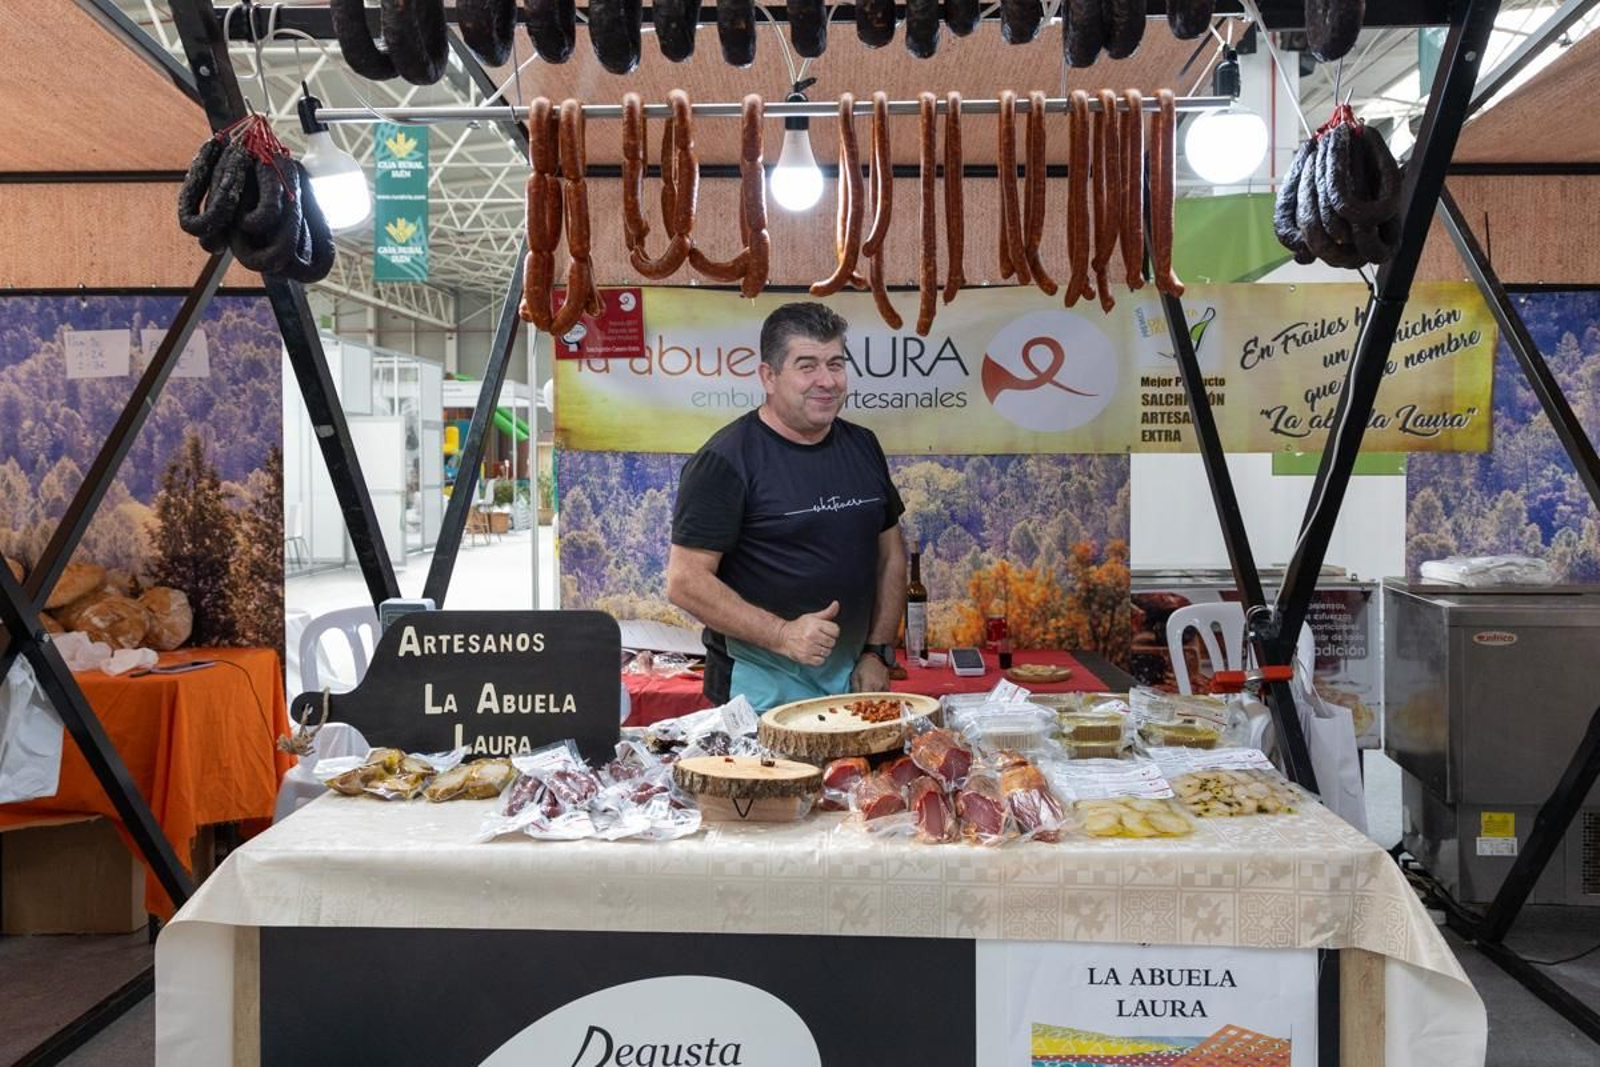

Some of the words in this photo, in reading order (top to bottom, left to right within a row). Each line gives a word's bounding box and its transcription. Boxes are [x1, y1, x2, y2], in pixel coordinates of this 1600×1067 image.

[1240, 336, 1276, 370] En
[1271, 316, 1349, 355] Frailes
[1323, 348, 1350, 368] un
[1394, 308, 1461, 343] ichón
[628, 334, 757, 377] abue
[844, 335, 970, 378] URA
[1140, 376, 1173, 388] Mejor
[1175, 376, 1226, 387] Pucto
[1303, 380, 1342, 412] que
[1404, 329, 1481, 368] nombre
[844, 386, 968, 409] rtesanales
[1141, 390, 1226, 406] SALCHIÓN
[1140, 411, 1194, 424] ARTESA
[1308, 408, 1391, 430] abla
[1140, 429, 1182, 442] EXTRA
[397, 625, 545, 657] ARTESANOS
[1314, 643, 1366, 657] adición
[424, 683, 458, 715] LA
[476, 682, 577, 715] ABUELA
[454, 723, 532, 756] LAURA
[1087, 967, 1121, 986] LA
[1129, 967, 1238, 988] ABUELA
[1115, 999, 1208, 1018] LAURA
[571, 1025, 742, 1067] Degusta
